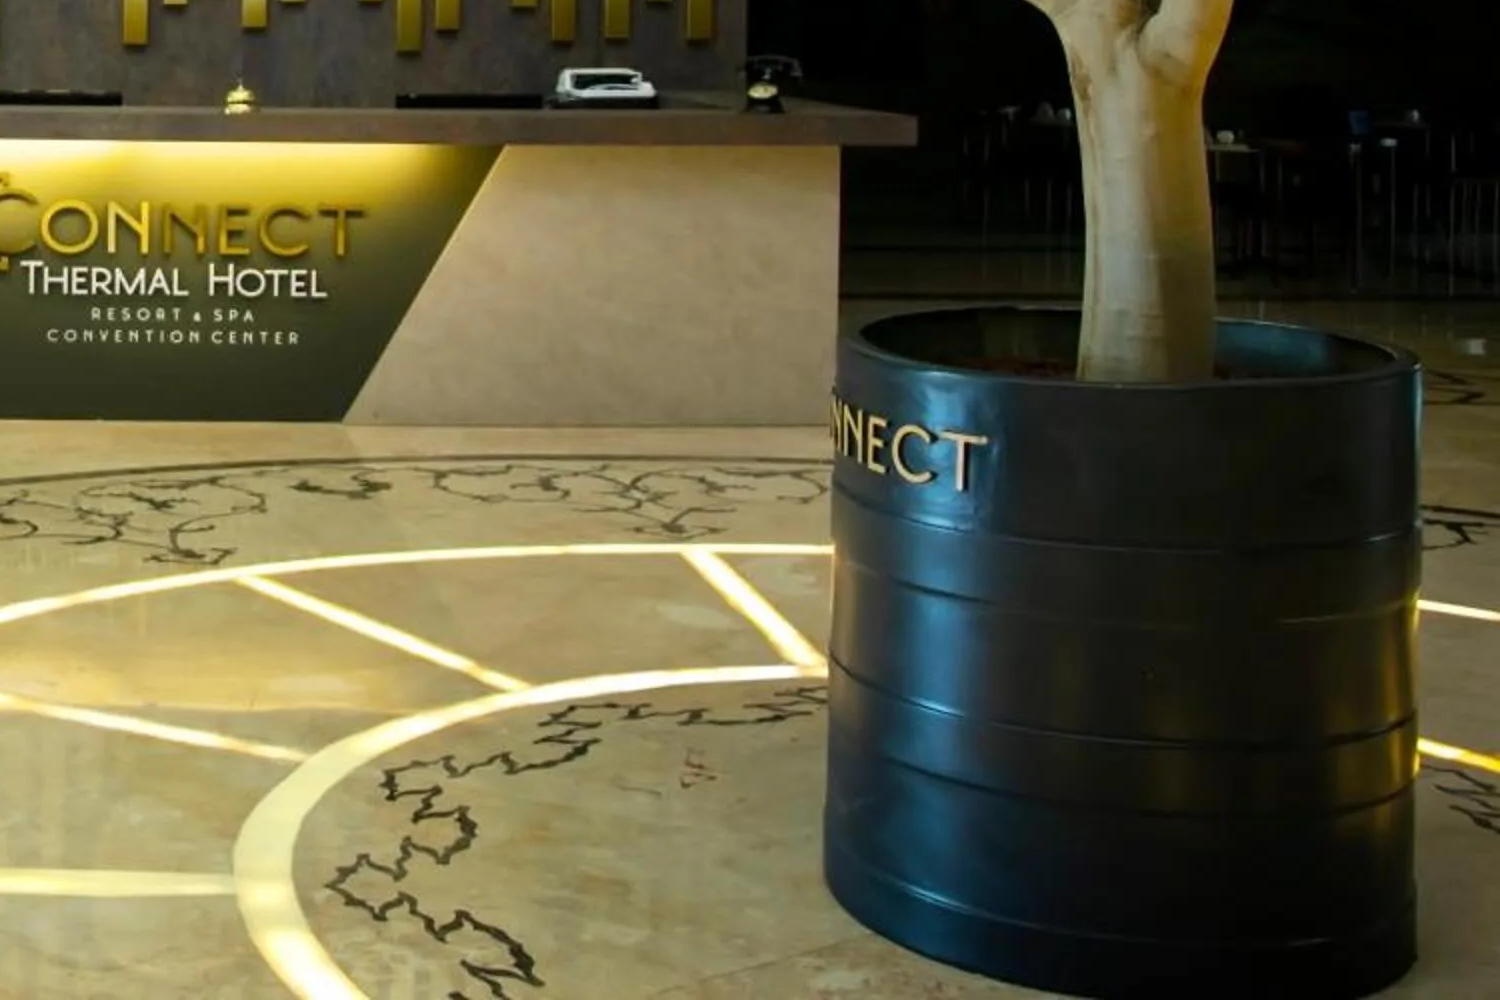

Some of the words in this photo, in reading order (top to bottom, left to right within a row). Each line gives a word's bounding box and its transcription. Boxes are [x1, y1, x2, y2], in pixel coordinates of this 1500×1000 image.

[20, 260, 188, 297] THERMAL
[208, 262, 328, 298] HOTEL
[91, 308, 182, 322] RESORT
[192, 311, 202, 323] &
[213, 309, 255, 323] SPA
[46, 327, 201, 345] CONVENTION
[210, 330, 300, 346] CENTER
